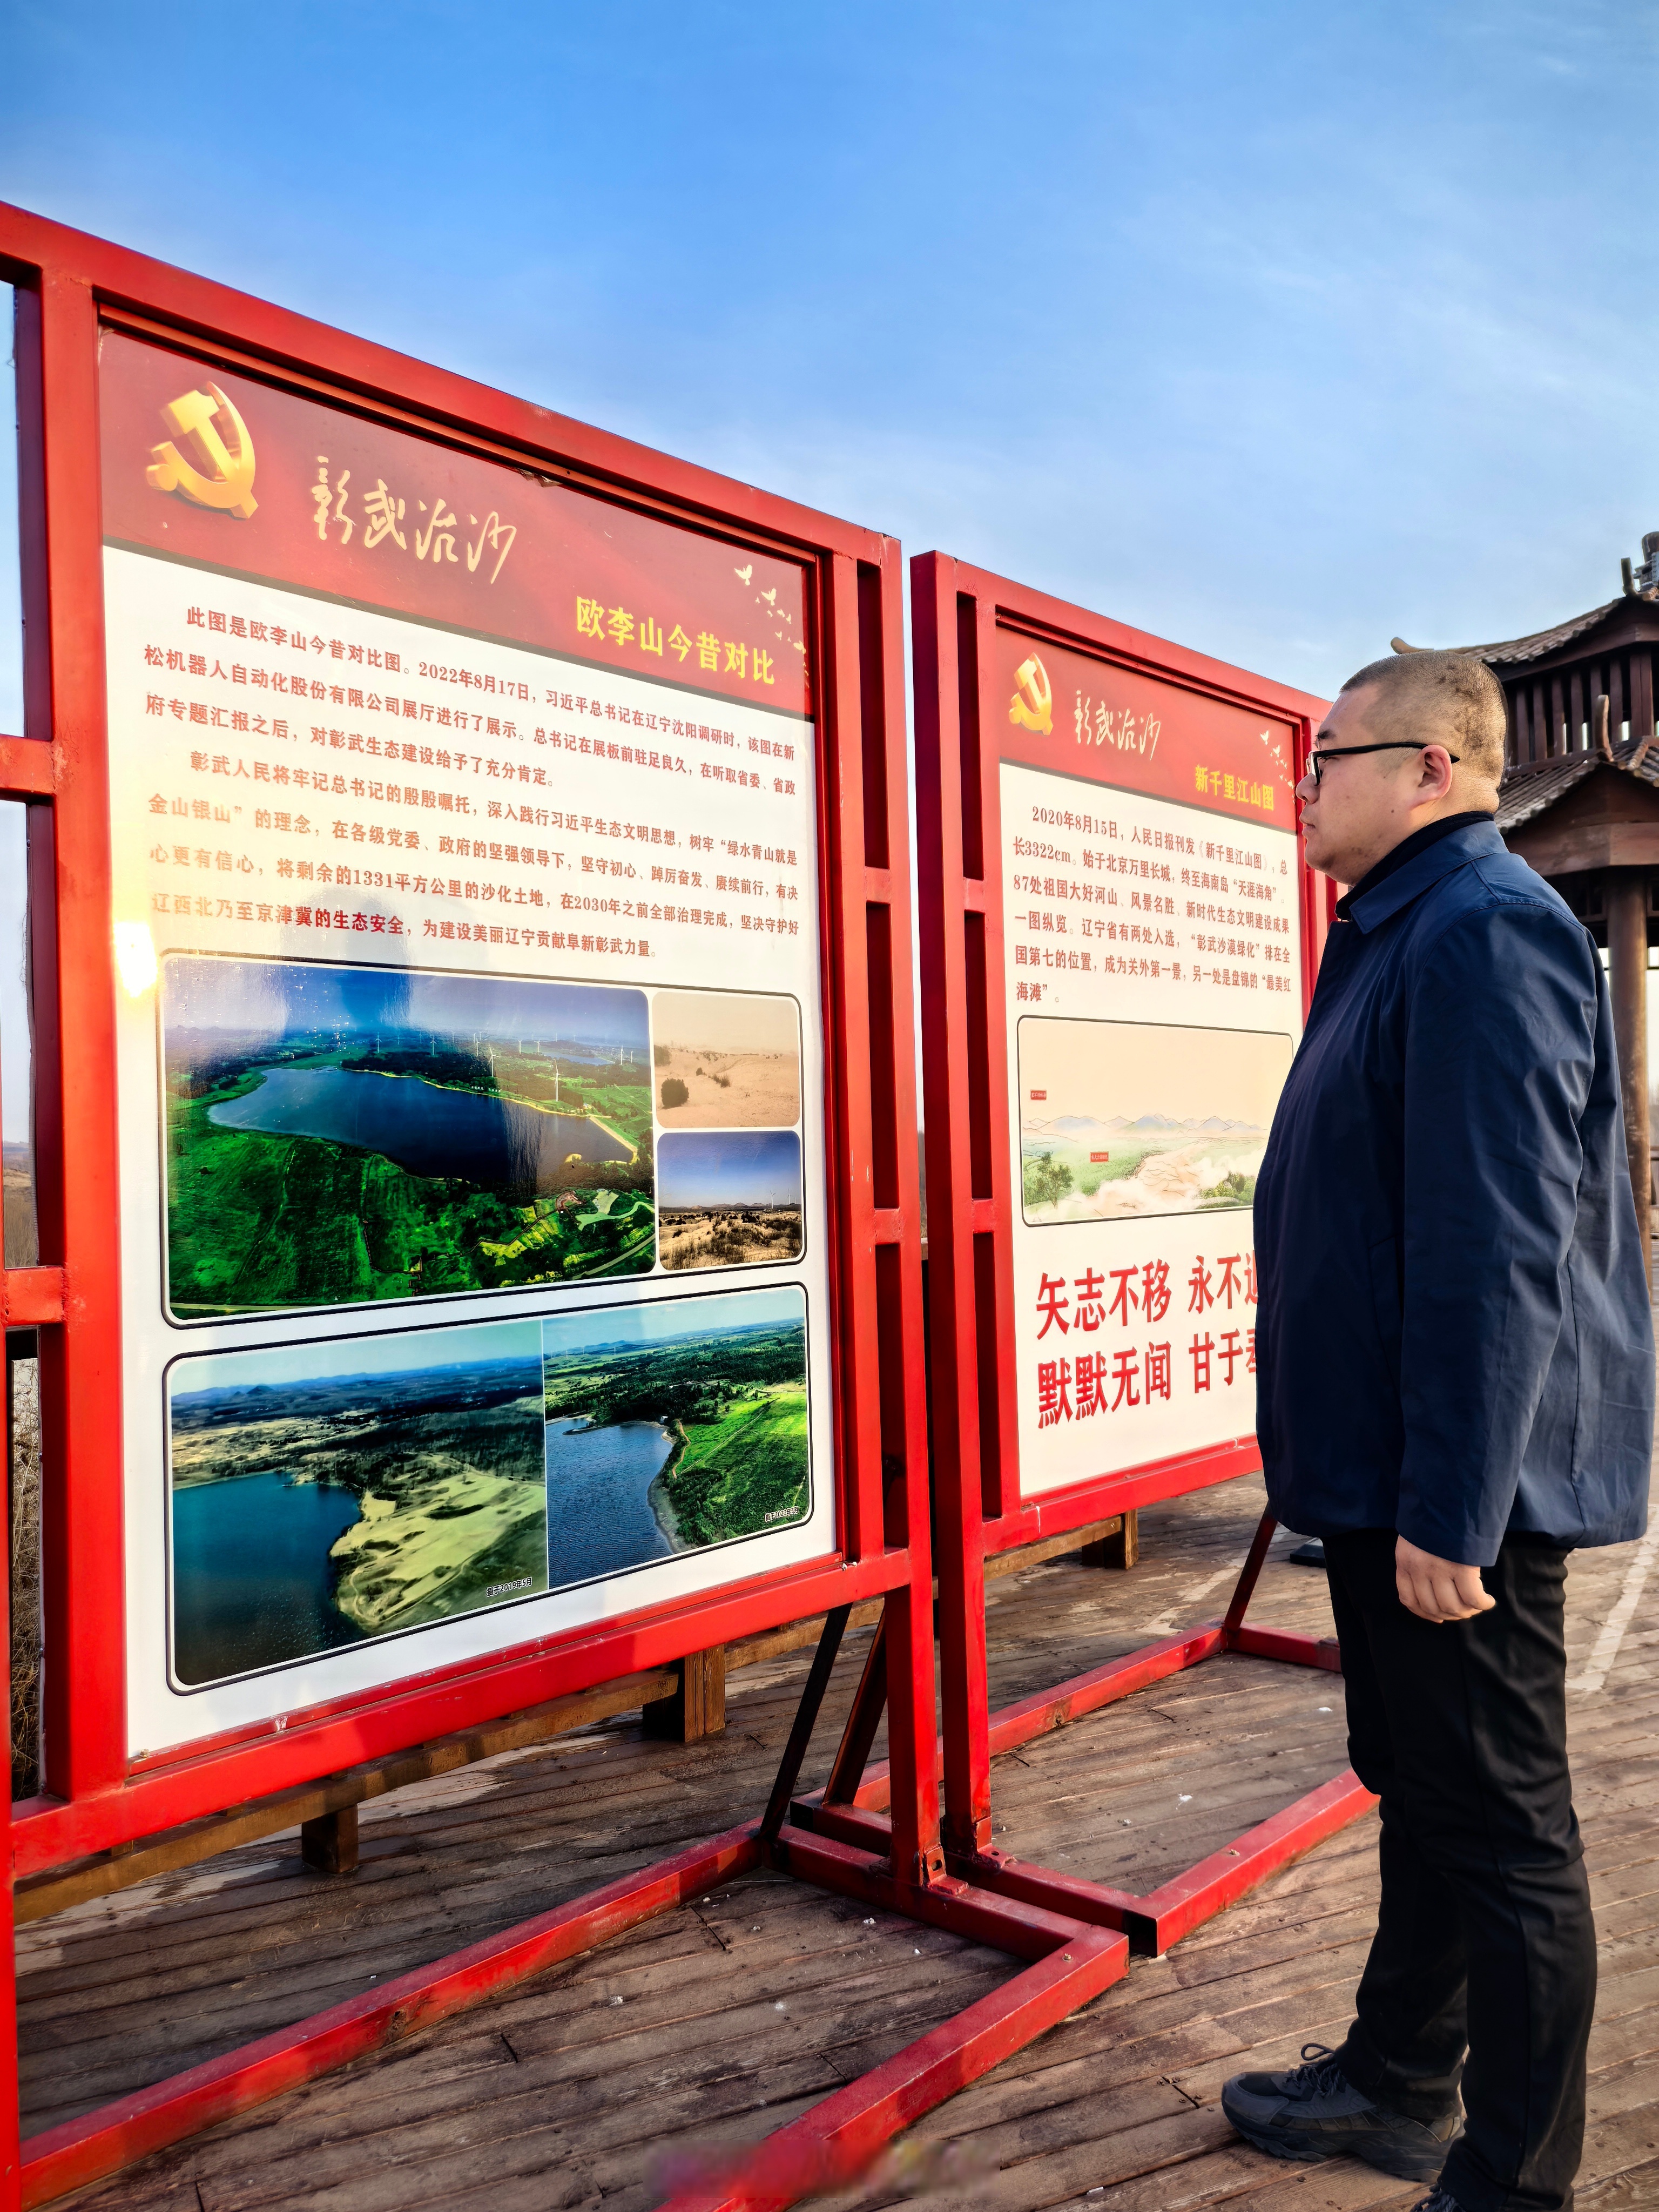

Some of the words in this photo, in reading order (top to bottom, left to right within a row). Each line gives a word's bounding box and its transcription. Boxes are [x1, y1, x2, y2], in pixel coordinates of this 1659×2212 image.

[576, 595, 775, 685] 欧李山今昔对比
[146, 694, 553, 787] 府专题汇报之后，对彰武生态建设给予了充分肯定。
[1195, 764, 1275, 811] 新千里江山图
[1032, 806, 1288, 875] 2020年8月15日，人民日报刊发《新千里江山图》，总
[1014, 874, 1290, 934] 87处祖国大好河山、风景名胜、新时代生态文明建设成果
[1036, 1258, 1172, 1340] 矢志不移
[1038, 1341, 1172, 1429] 默默无闻
